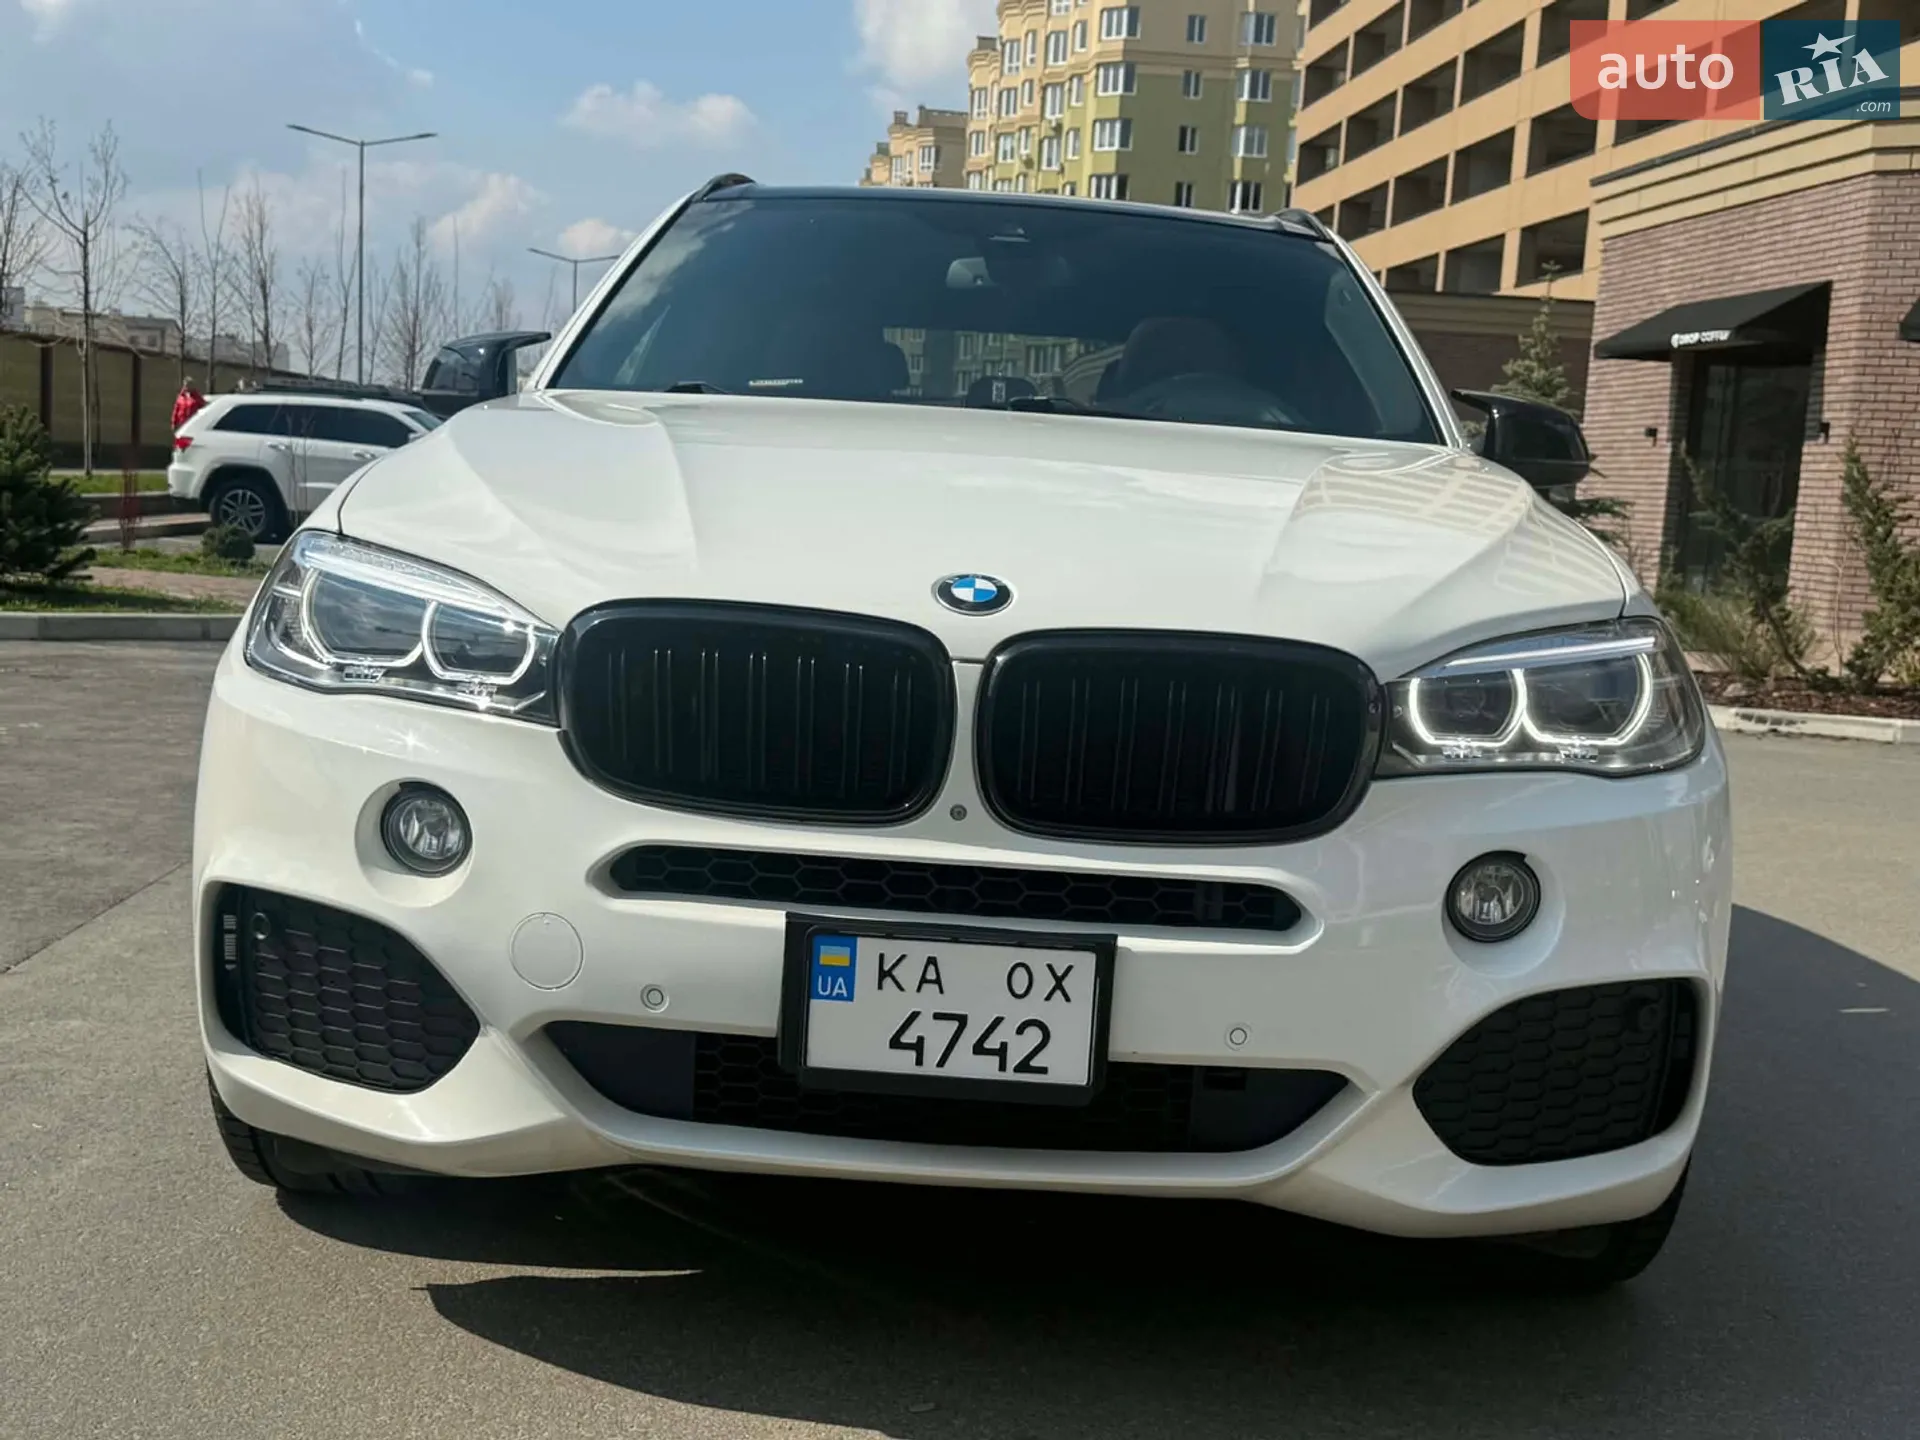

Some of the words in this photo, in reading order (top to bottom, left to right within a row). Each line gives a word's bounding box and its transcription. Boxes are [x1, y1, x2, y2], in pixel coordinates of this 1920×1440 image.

[817, 975, 848, 998] UA
[877, 952, 945, 995] KA
[888, 1010, 1052, 1075] 4742
